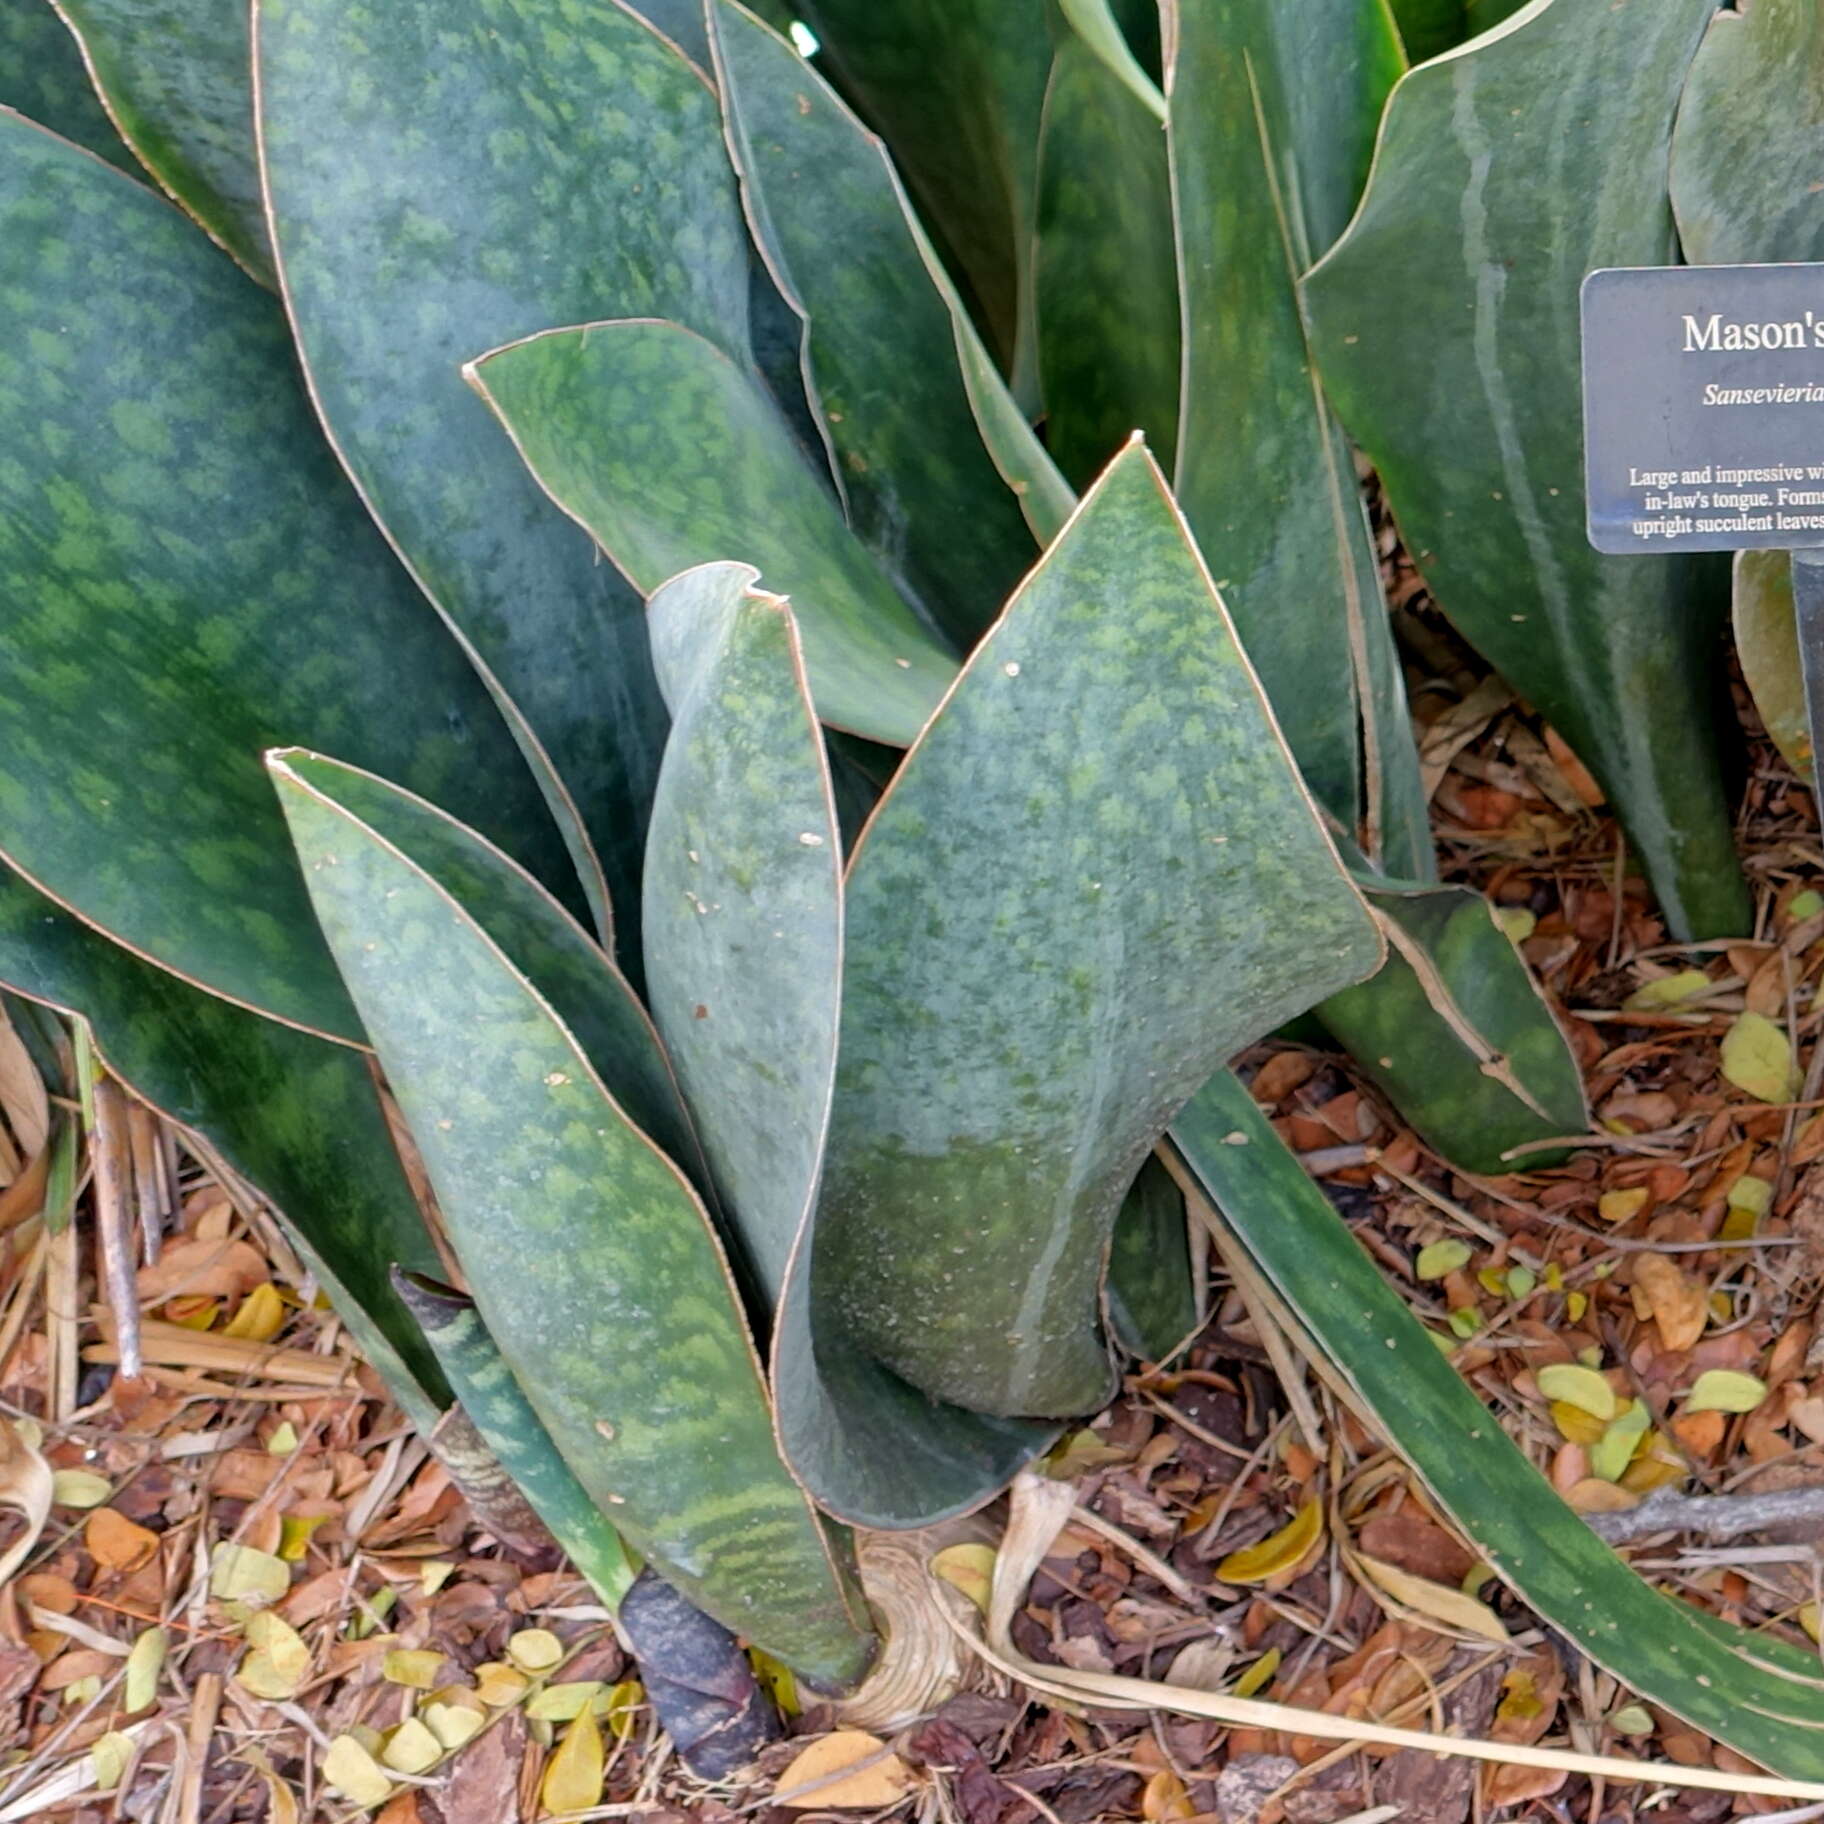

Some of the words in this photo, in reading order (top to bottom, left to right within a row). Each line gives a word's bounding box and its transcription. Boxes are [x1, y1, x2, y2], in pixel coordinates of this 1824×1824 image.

[1630, 467, 1678, 489] Large
[1682, 465, 1712, 484] and
[1716, 464, 1803, 486] impressive
[1645, 490, 1709, 510] in-law's
[1713, 488, 1773, 510] tongue.
[1633, 516, 1692, 538] upright
[1695, 512, 1772, 532] succulent
